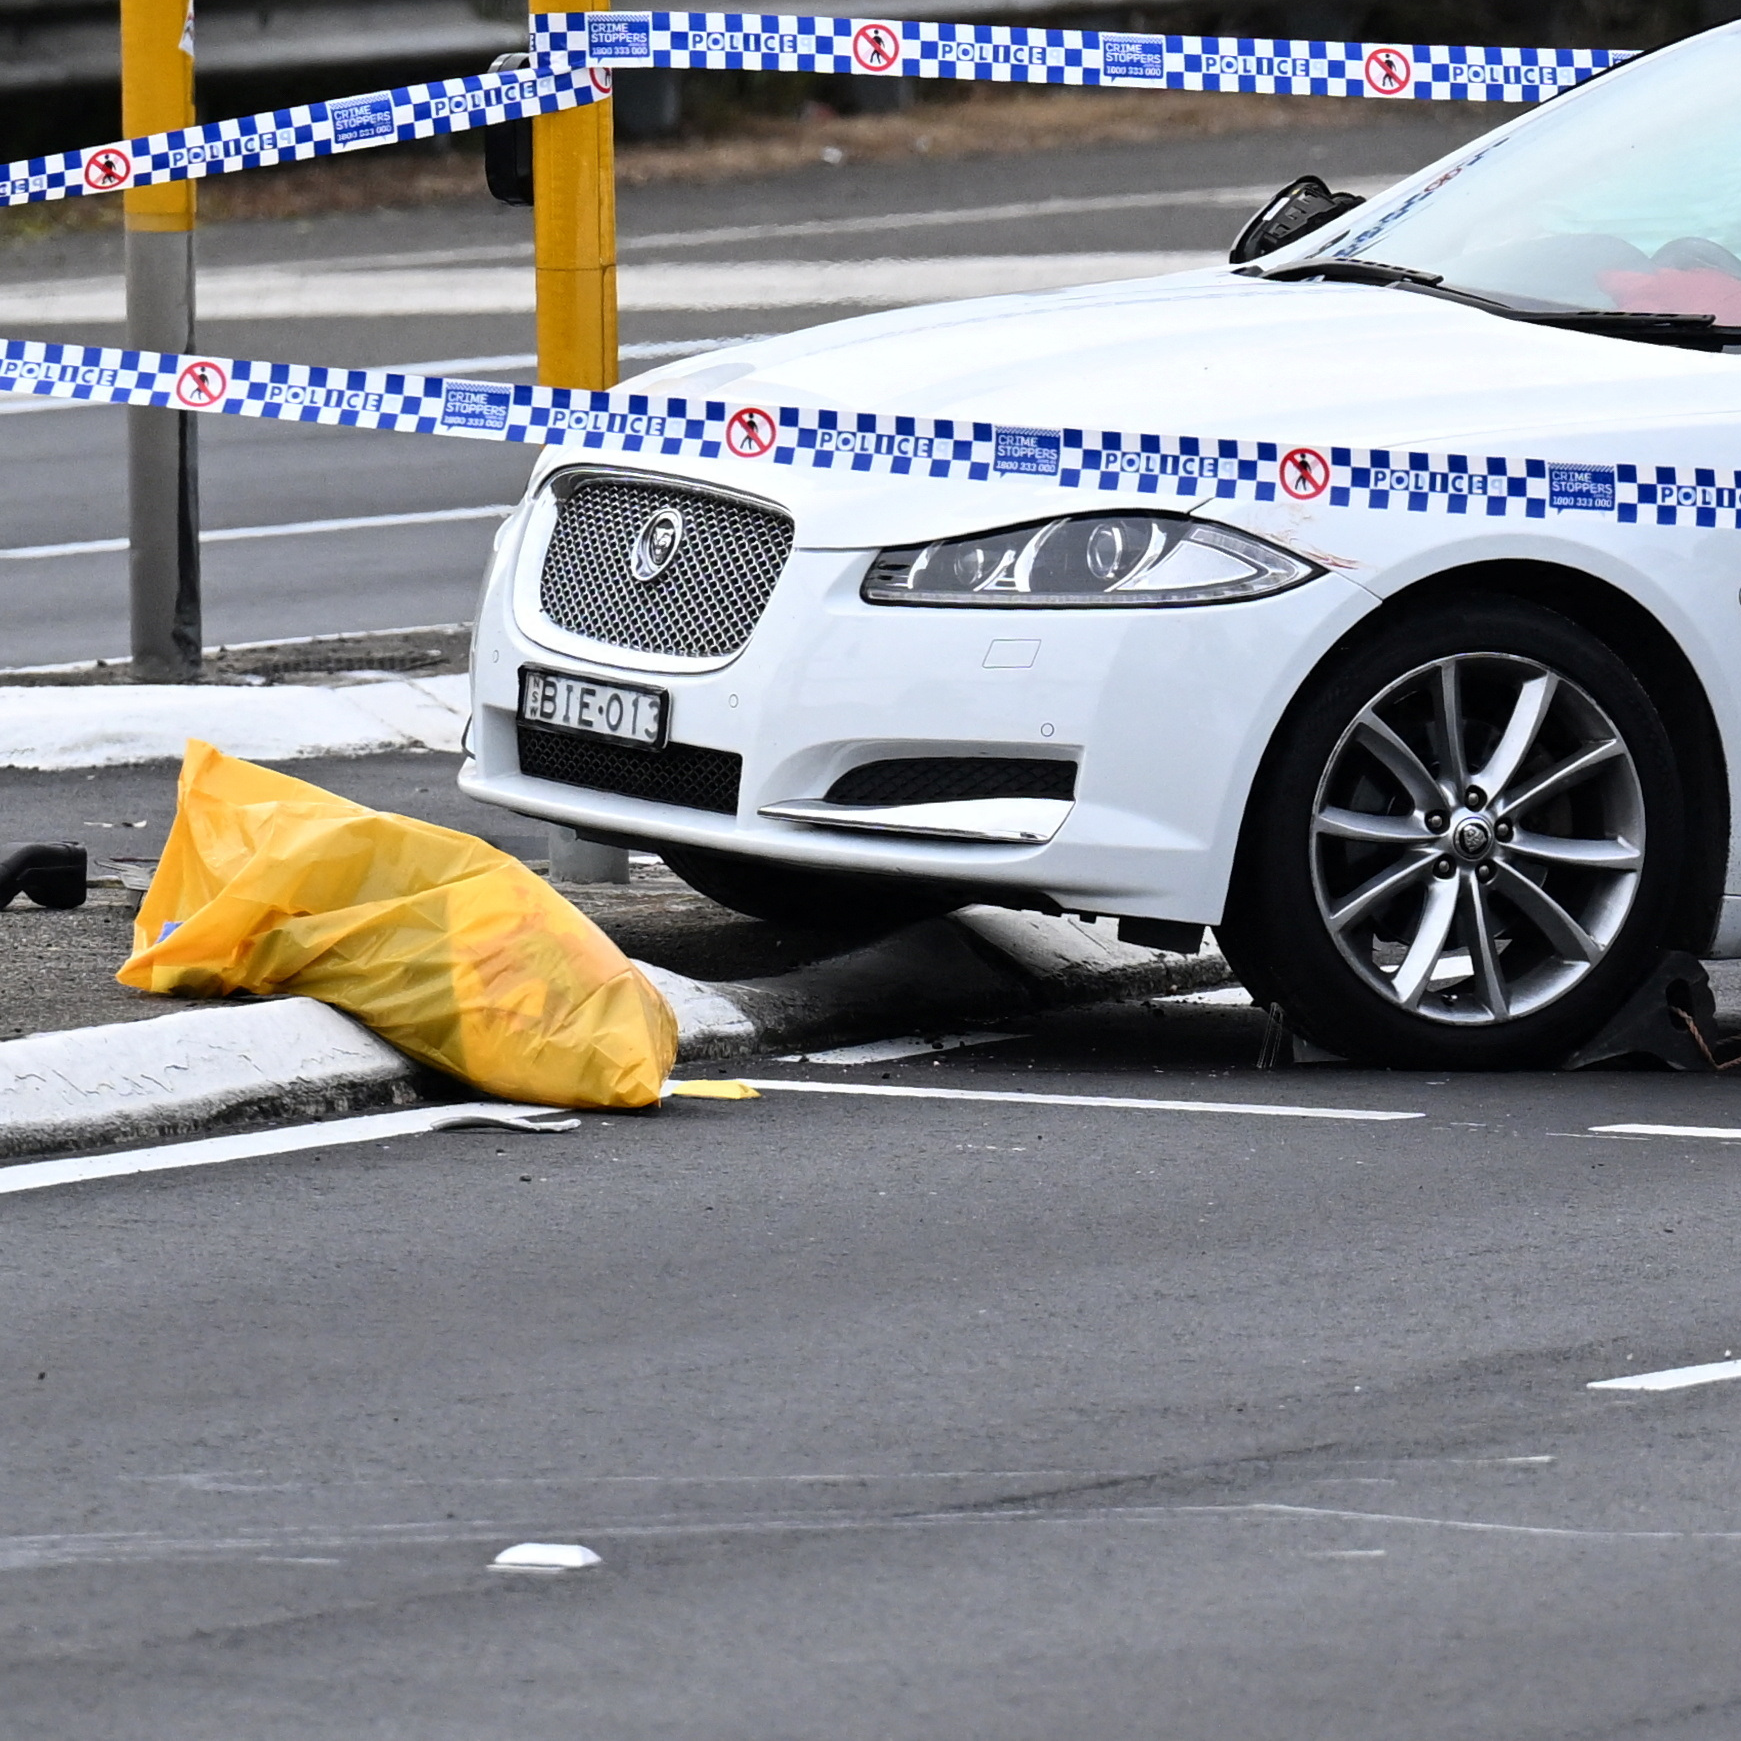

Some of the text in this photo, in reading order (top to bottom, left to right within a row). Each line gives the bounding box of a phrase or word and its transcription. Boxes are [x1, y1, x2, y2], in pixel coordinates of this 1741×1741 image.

[591, 23, 628, 33] CRIME
[591, 33, 647, 42] STOPPERS
[692, 34, 796, 52] POLICE
[940, 42, 1044, 63] POLICE
[1106, 43, 1142, 53] CRIME
[1106, 52, 1161, 63] STOPPERS
[1205, 56, 1309, 76] POLICE
[1452, 66, 1555, 85] POLICE
[435, 81, 536, 115] POLICE
[334, 105, 370, 120] CRIME
[336, 112, 390, 130] STOPPERS
[172, 133, 274, 166] POLICE
[2, 360, 116, 387] POLICE
[269, 387, 380, 411] POLICE
[448, 391, 489, 403] CRIME
[446, 402, 506, 416] STOPPERS
[553, 411, 664, 435] POLICE
[819, 431, 931, 457] POLICE
[998, 434, 1038, 447] CRIME
[997, 445, 1058, 459] STOPPERS
[1105, 453, 1216, 478] POLICE
[1374, 471, 1485, 494] POLICE
[1552, 470, 1592, 482] CRIME
[1552, 481, 1612, 494] STOPPERS
